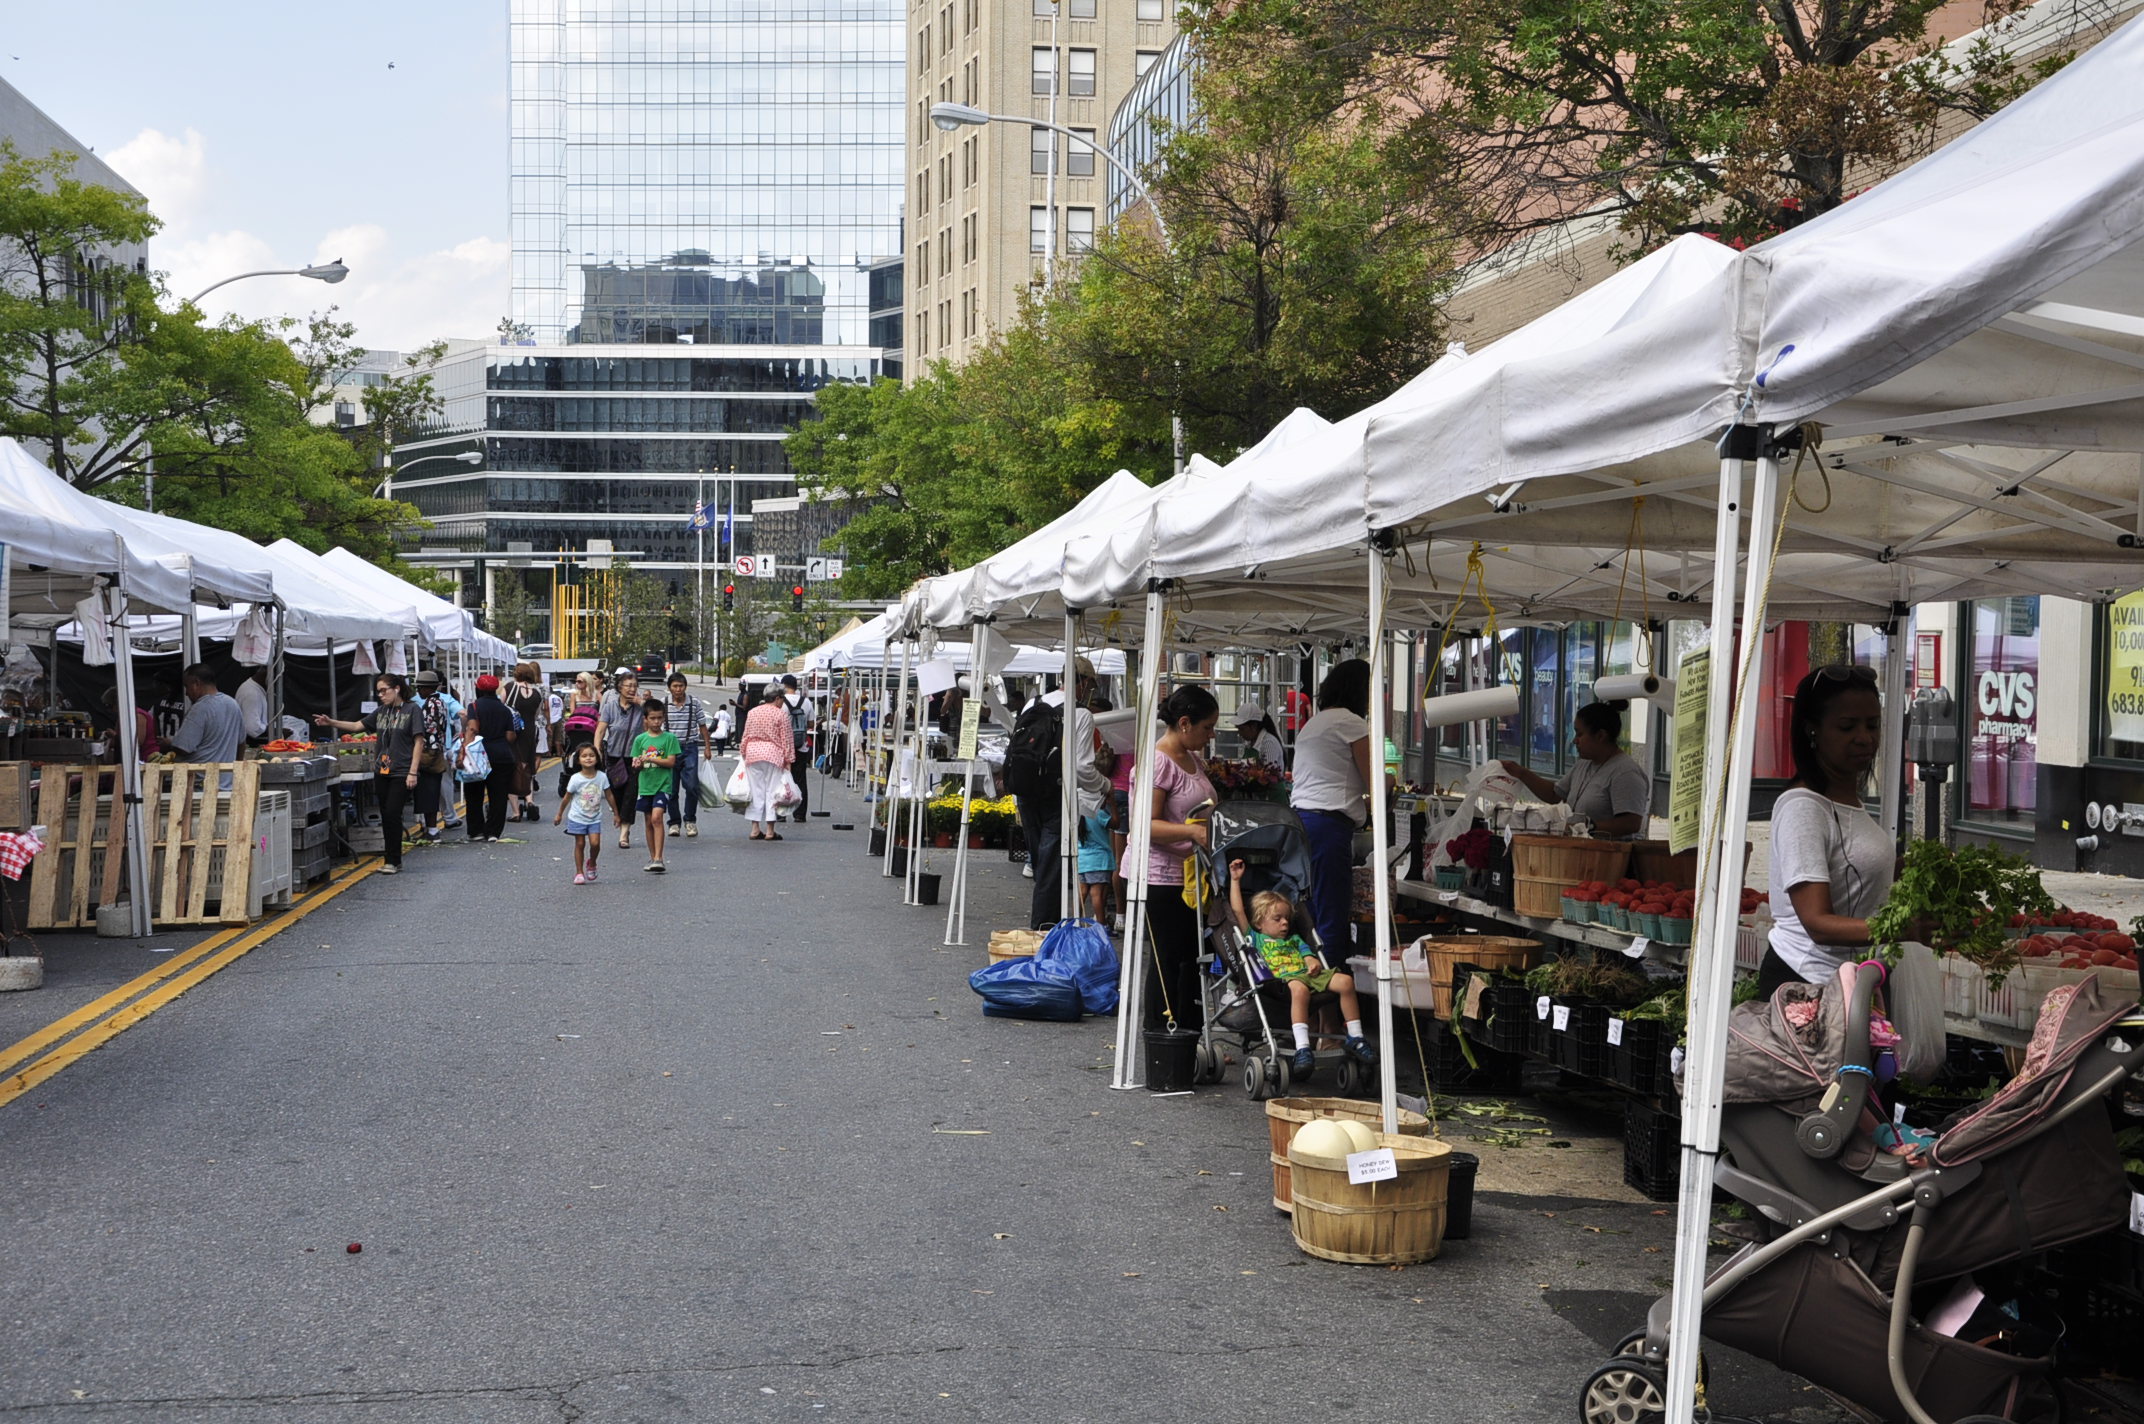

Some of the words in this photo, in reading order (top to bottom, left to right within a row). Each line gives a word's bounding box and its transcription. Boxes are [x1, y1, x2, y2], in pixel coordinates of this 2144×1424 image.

[1446, 664, 1456, 679] baby
[1499, 652, 1522, 682] CVS
[1534, 666, 1554, 686] beauty
[1978, 670, 2034, 719] CVS
[1979, 717, 2032, 739] pharmacy
